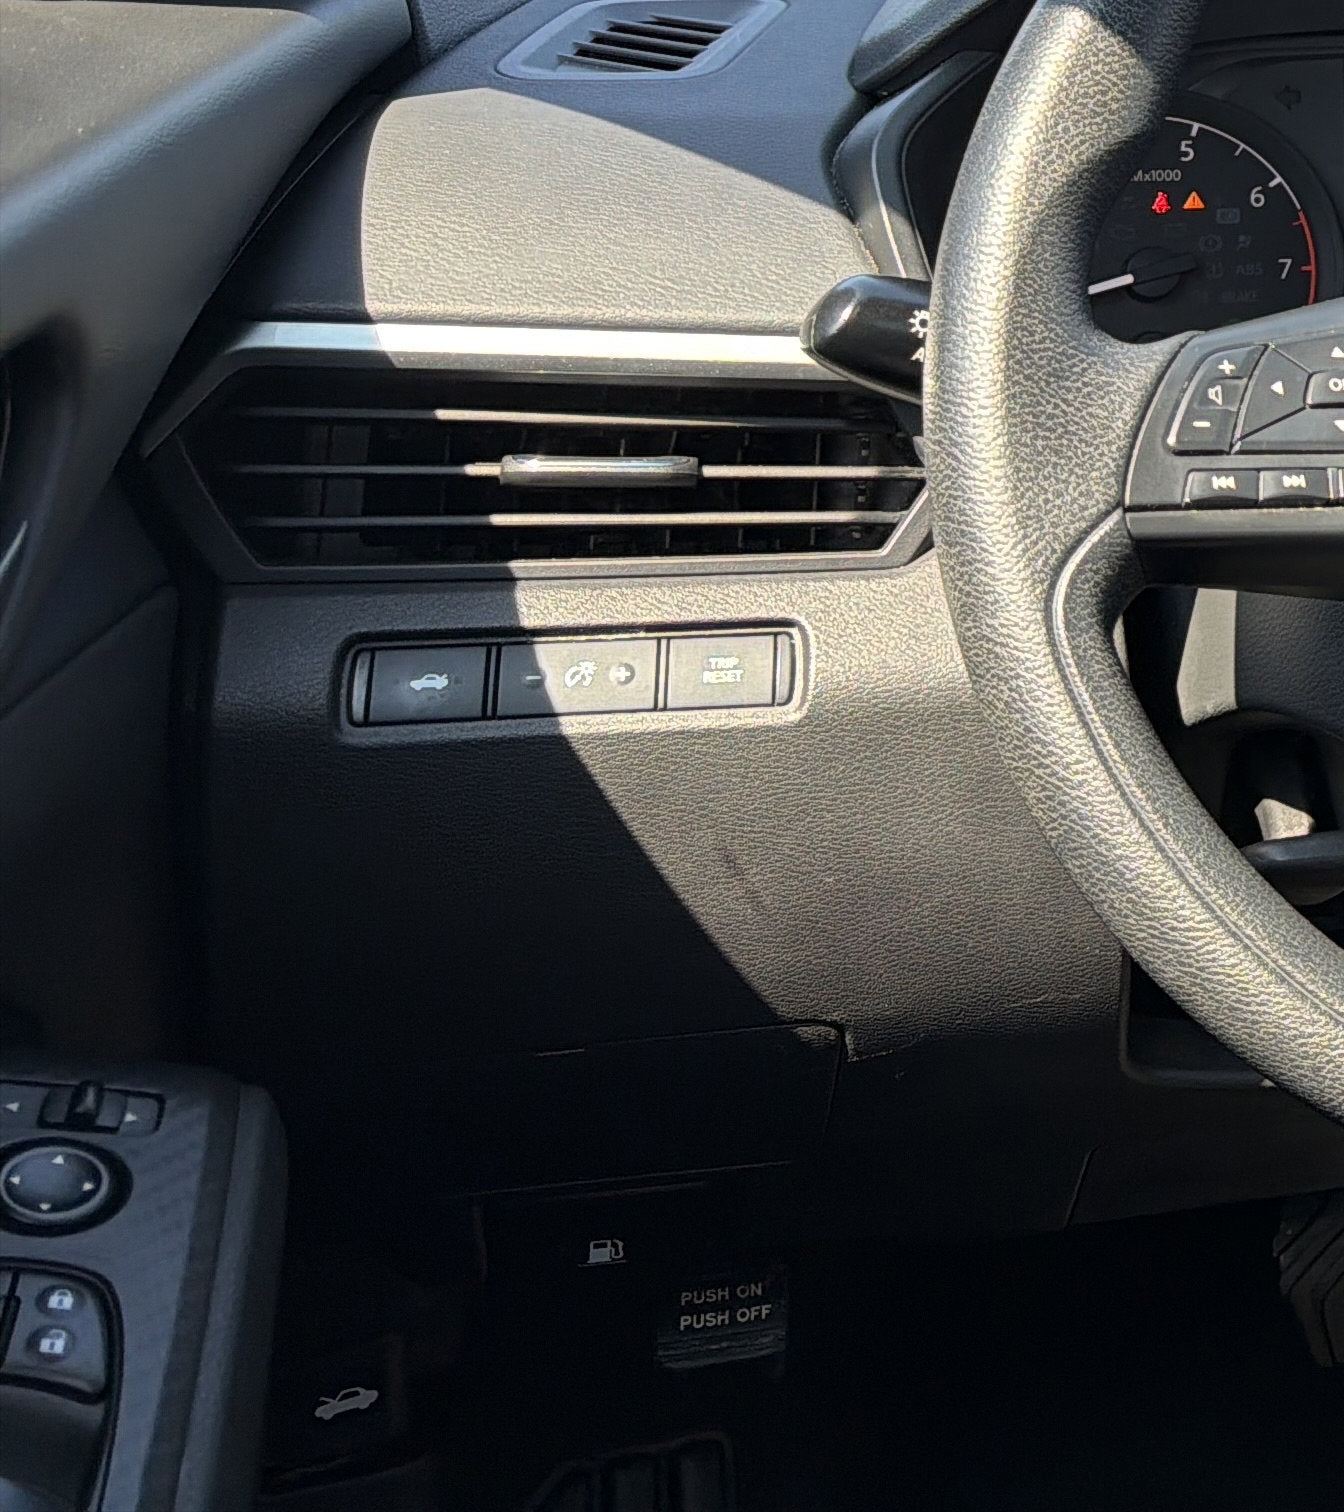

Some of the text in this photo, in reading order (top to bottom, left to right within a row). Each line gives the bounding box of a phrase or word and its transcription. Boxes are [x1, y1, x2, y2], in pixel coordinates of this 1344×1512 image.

[1179, 140, 1195, 162] 5
[1250, 186, 1265, 208] 6
[1278, 259, 1293, 279] 7
[702, 669, 745, 684] RESET
[680, 1282, 763, 1306] PUSH ON
[679, 1303, 773, 1331] PUSH OFF
